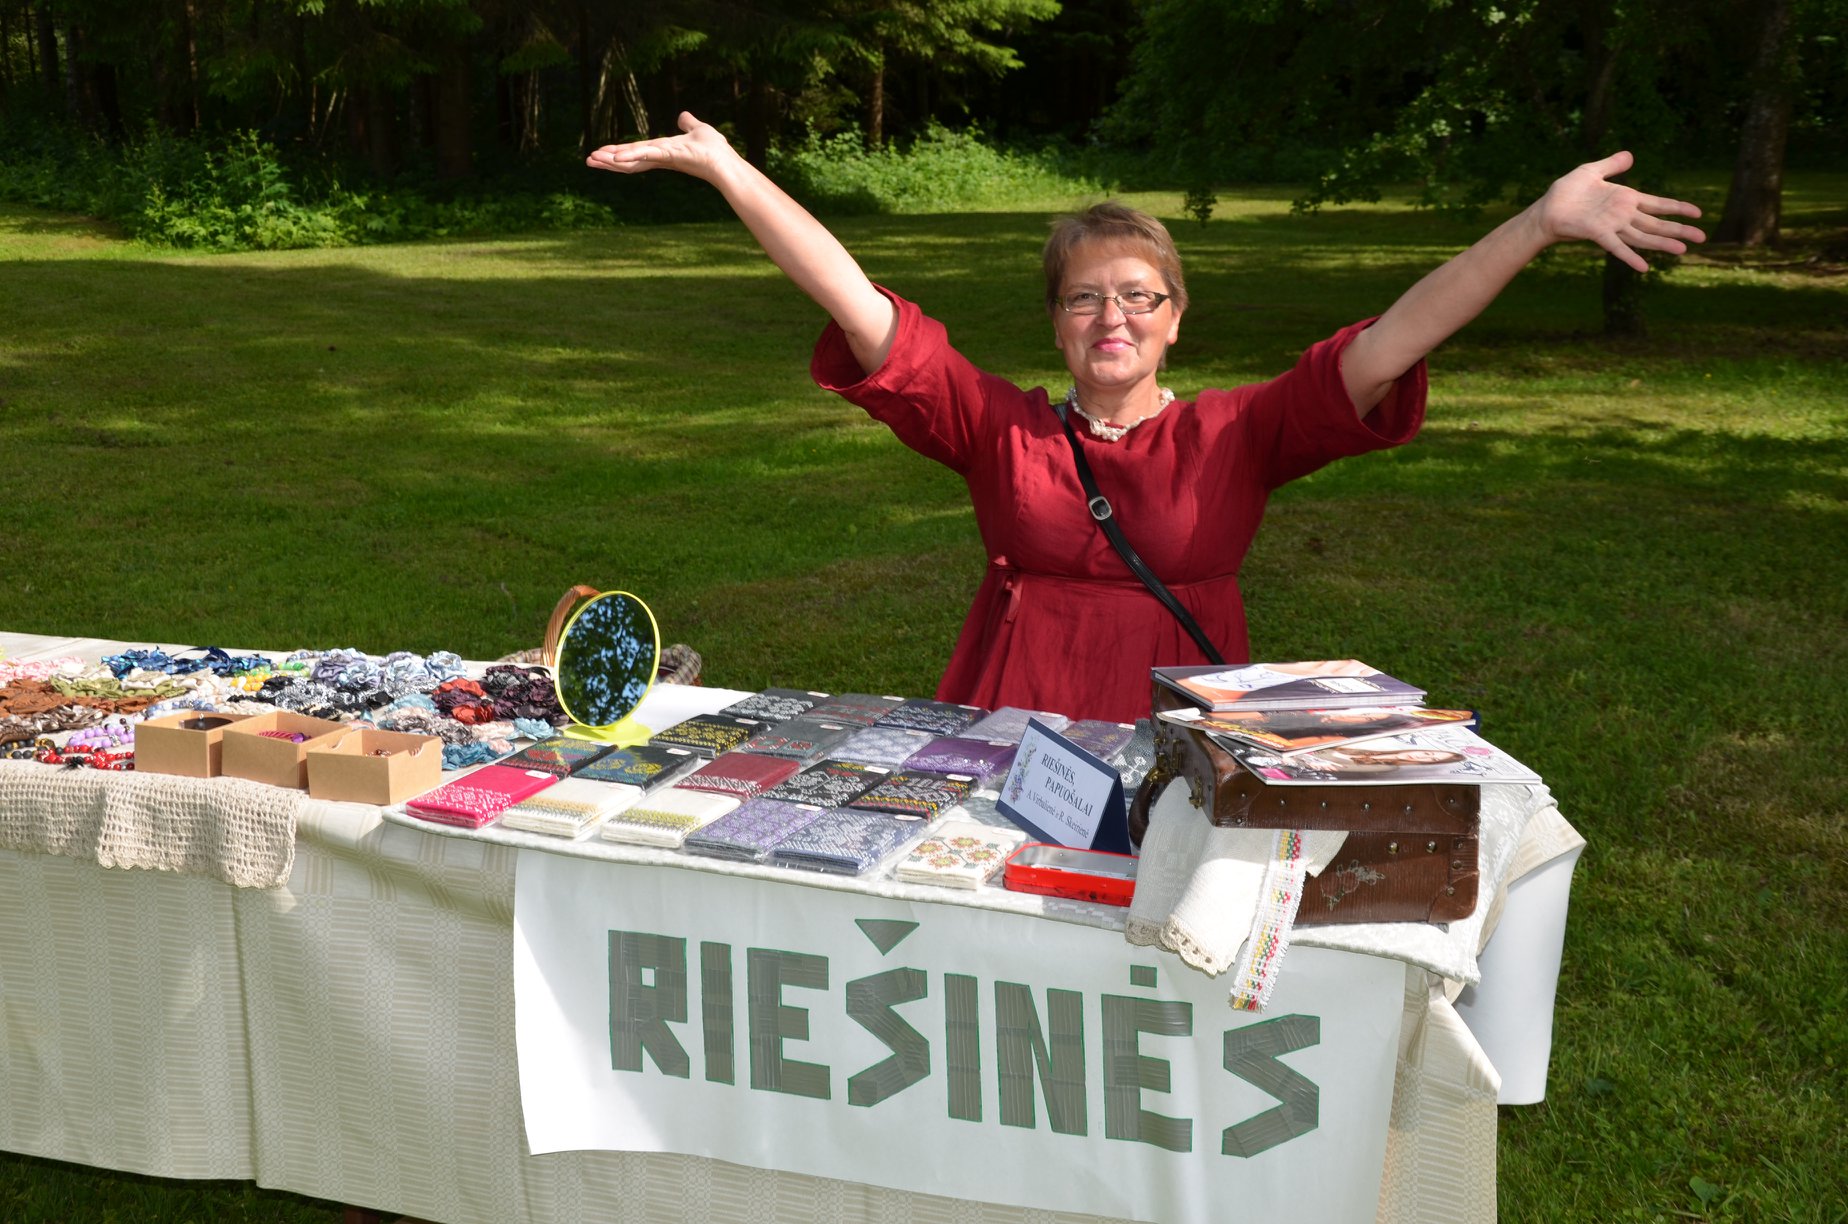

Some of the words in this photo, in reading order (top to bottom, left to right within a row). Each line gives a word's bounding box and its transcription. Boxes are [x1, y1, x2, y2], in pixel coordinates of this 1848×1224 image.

[1041, 753, 1076, 785] RIEŠINĖS,
[1045, 776, 1093, 817] PAPUOŠALAI
[608, 919, 1320, 1158] RIEŠINĖS
